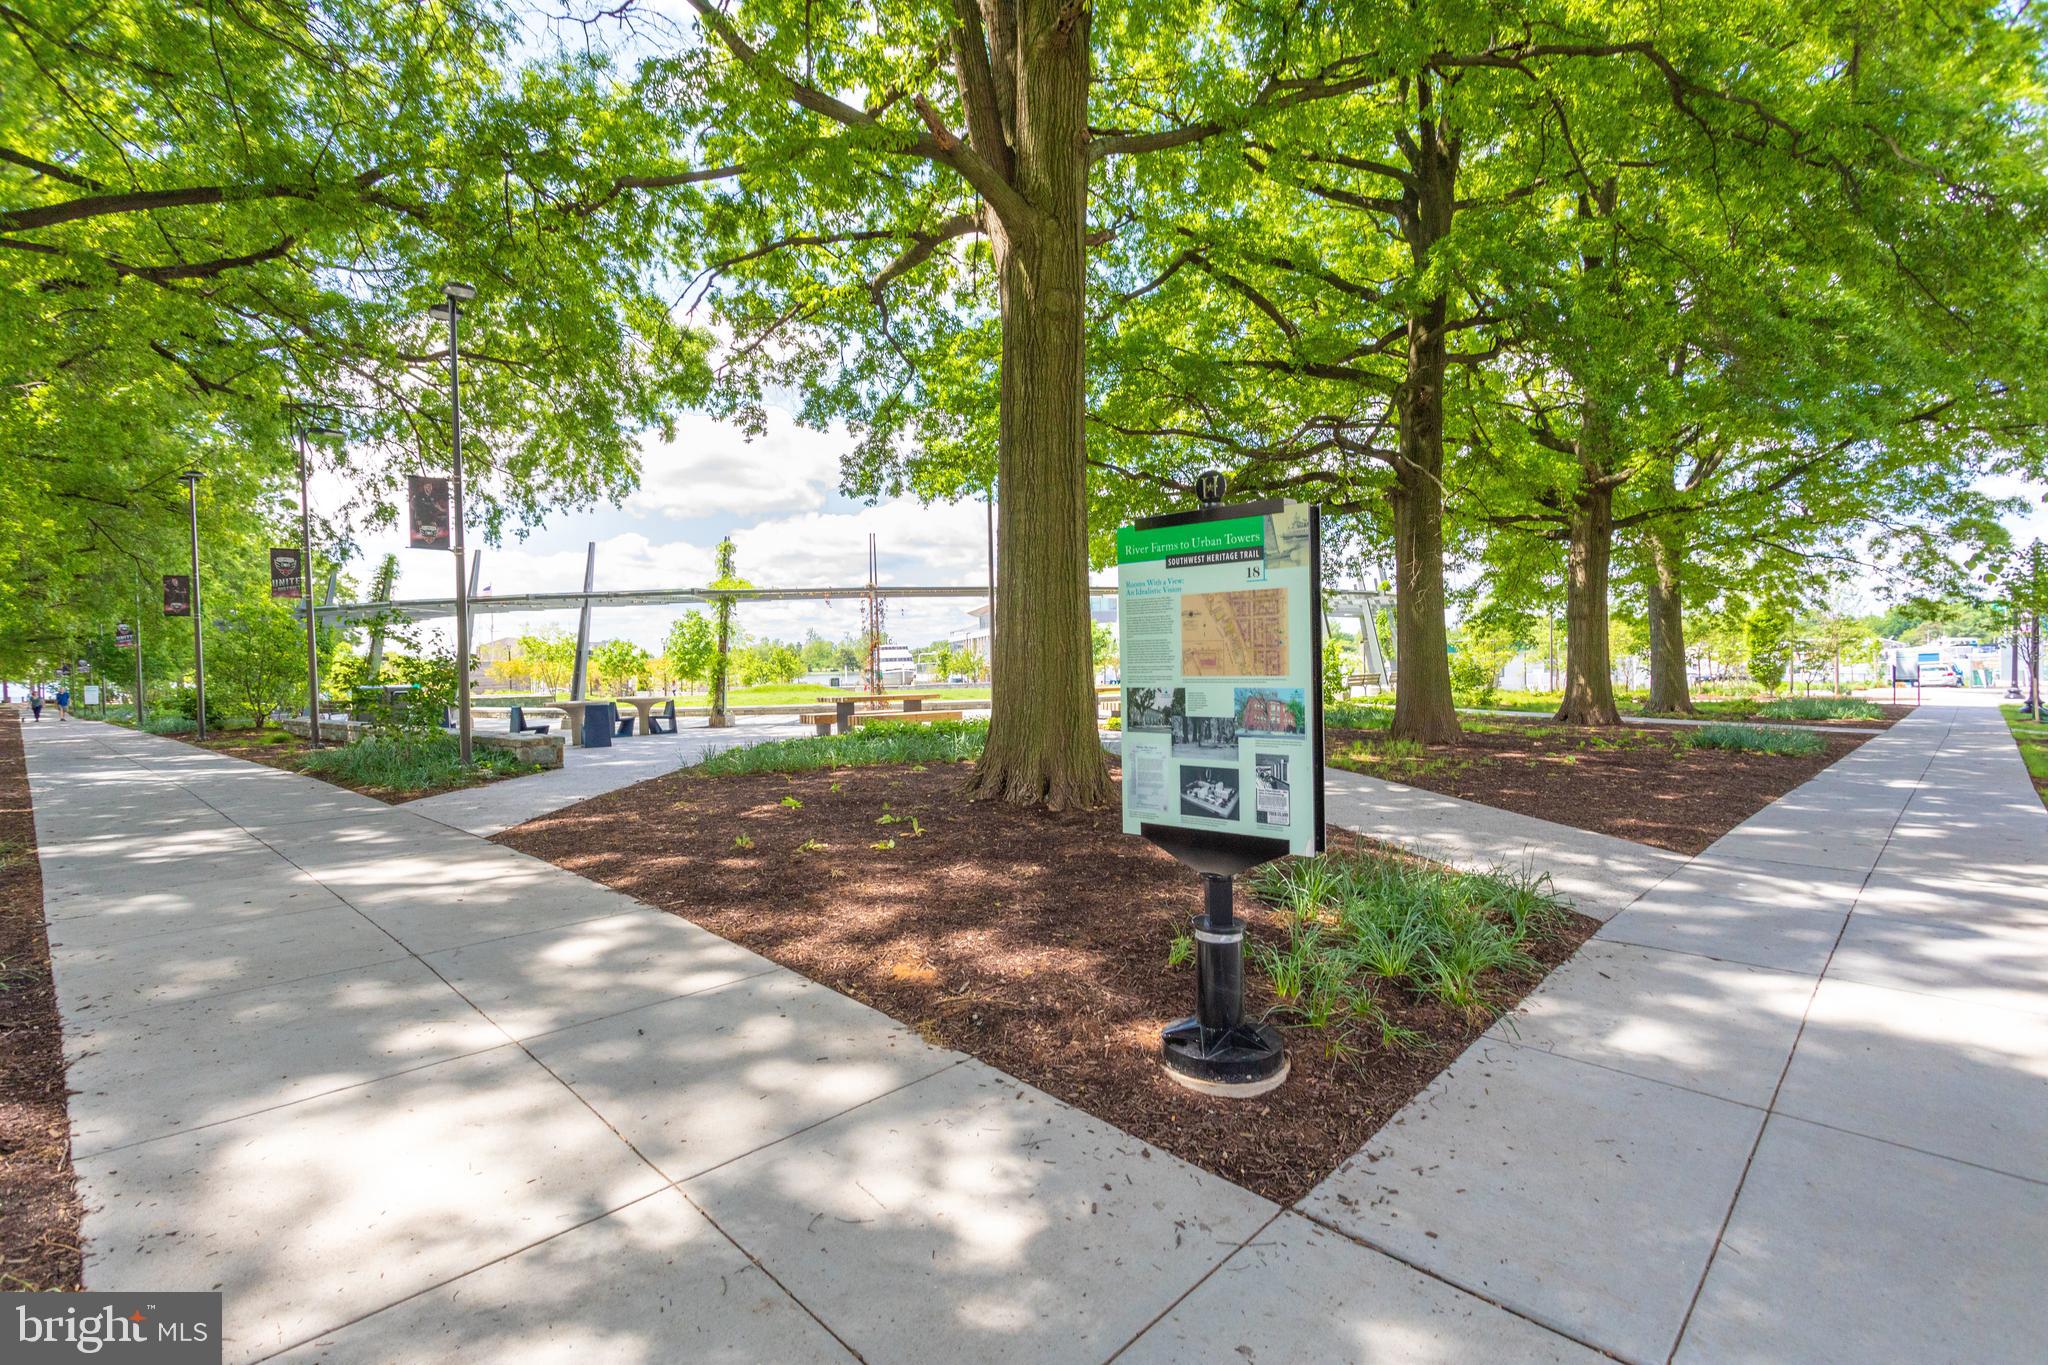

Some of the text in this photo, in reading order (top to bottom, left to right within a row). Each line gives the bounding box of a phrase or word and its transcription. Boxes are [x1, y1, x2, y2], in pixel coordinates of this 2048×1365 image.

[1125, 532, 1261, 556] River Farms to Urban Towers
[1167, 549, 1260, 566] SOUTHWEST HERITAGE TRAIL
[1247, 566, 1260, 578] 18
[1147, 578, 1162, 587] With
